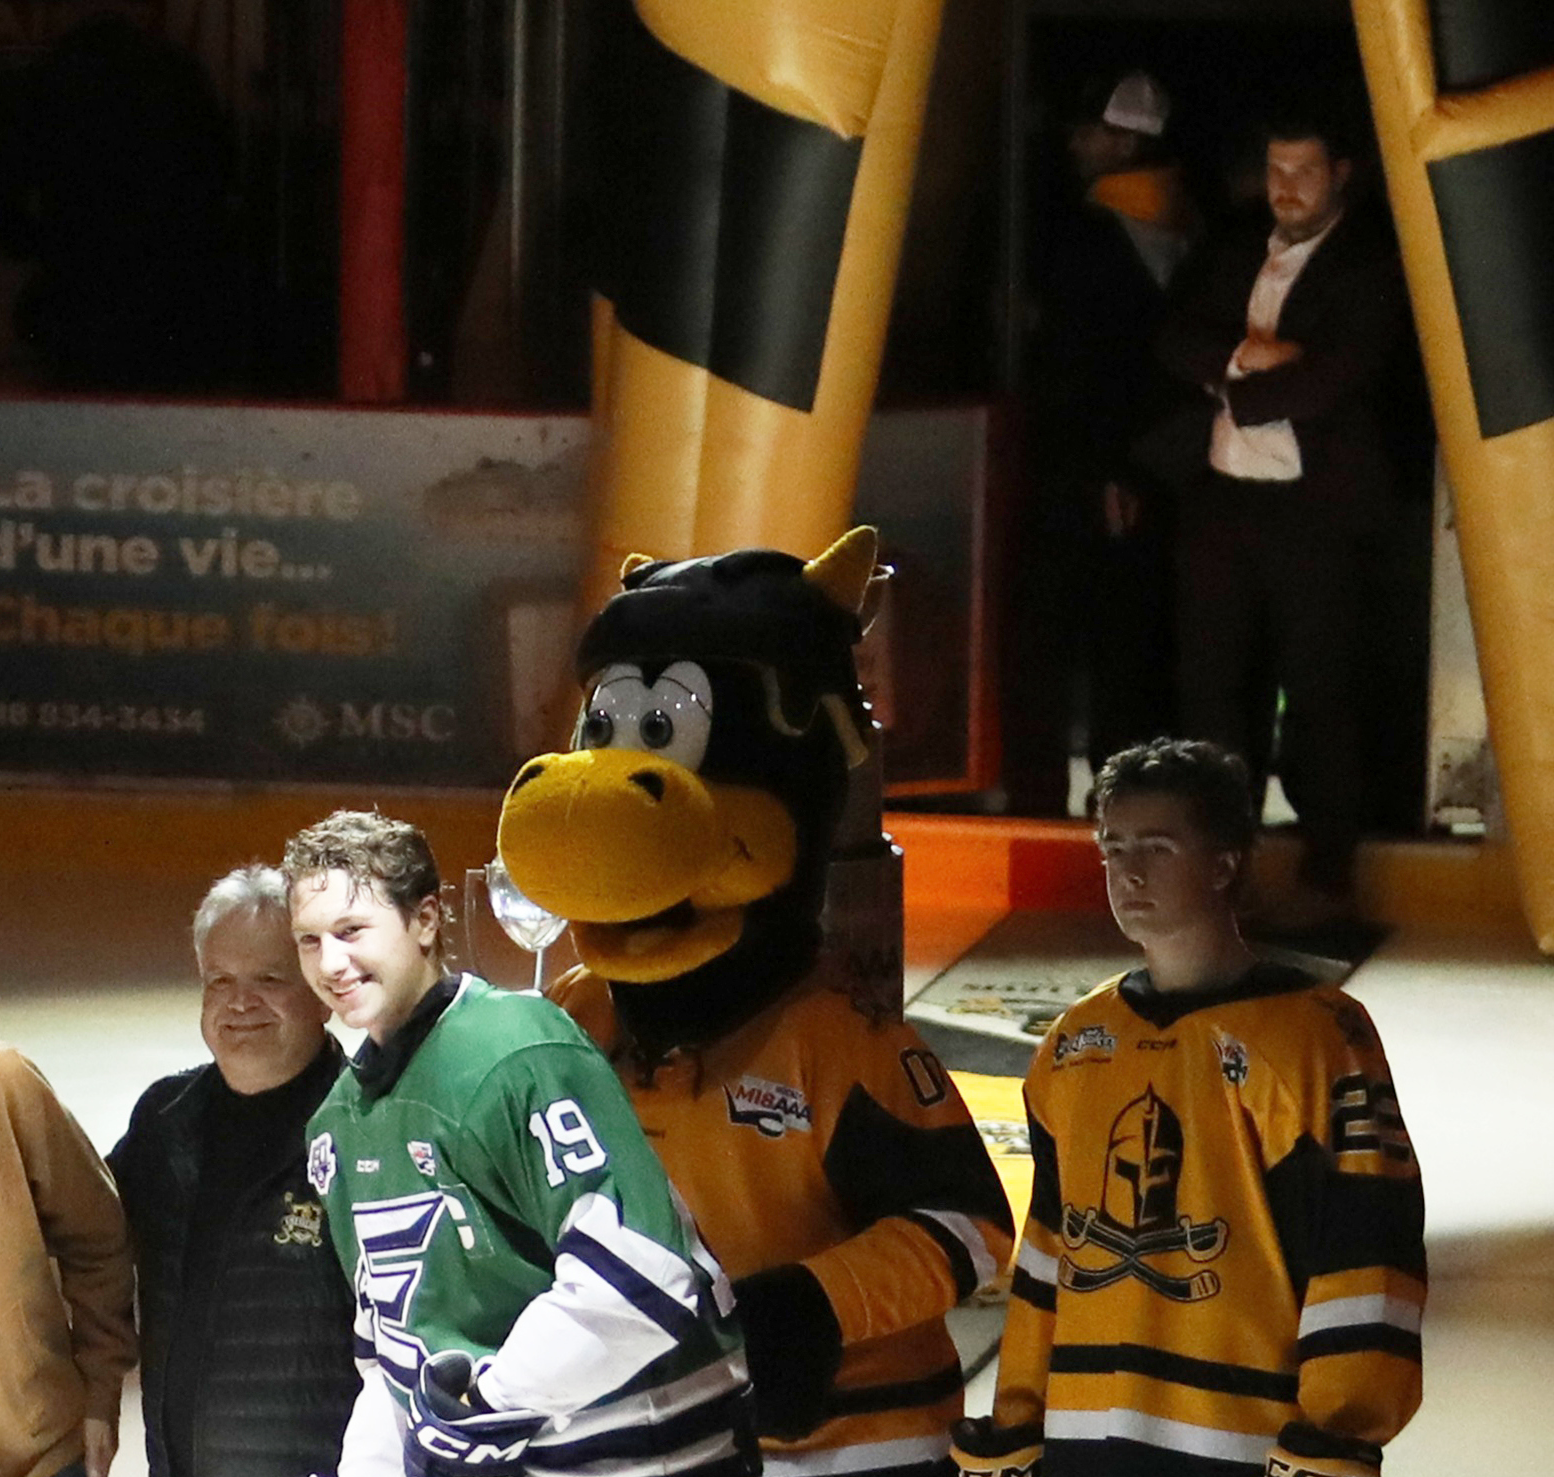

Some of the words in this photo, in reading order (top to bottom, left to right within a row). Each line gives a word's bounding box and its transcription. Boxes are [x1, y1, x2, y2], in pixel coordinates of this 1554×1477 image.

[73, 464, 362, 521] croisière
[178, 527, 333, 580] vie...
[249, 602, 393, 657] fois!
[339, 703, 456, 742] MSC
[530, 1099, 609, 1188] 19
[407, 1416, 531, 1465] CM
